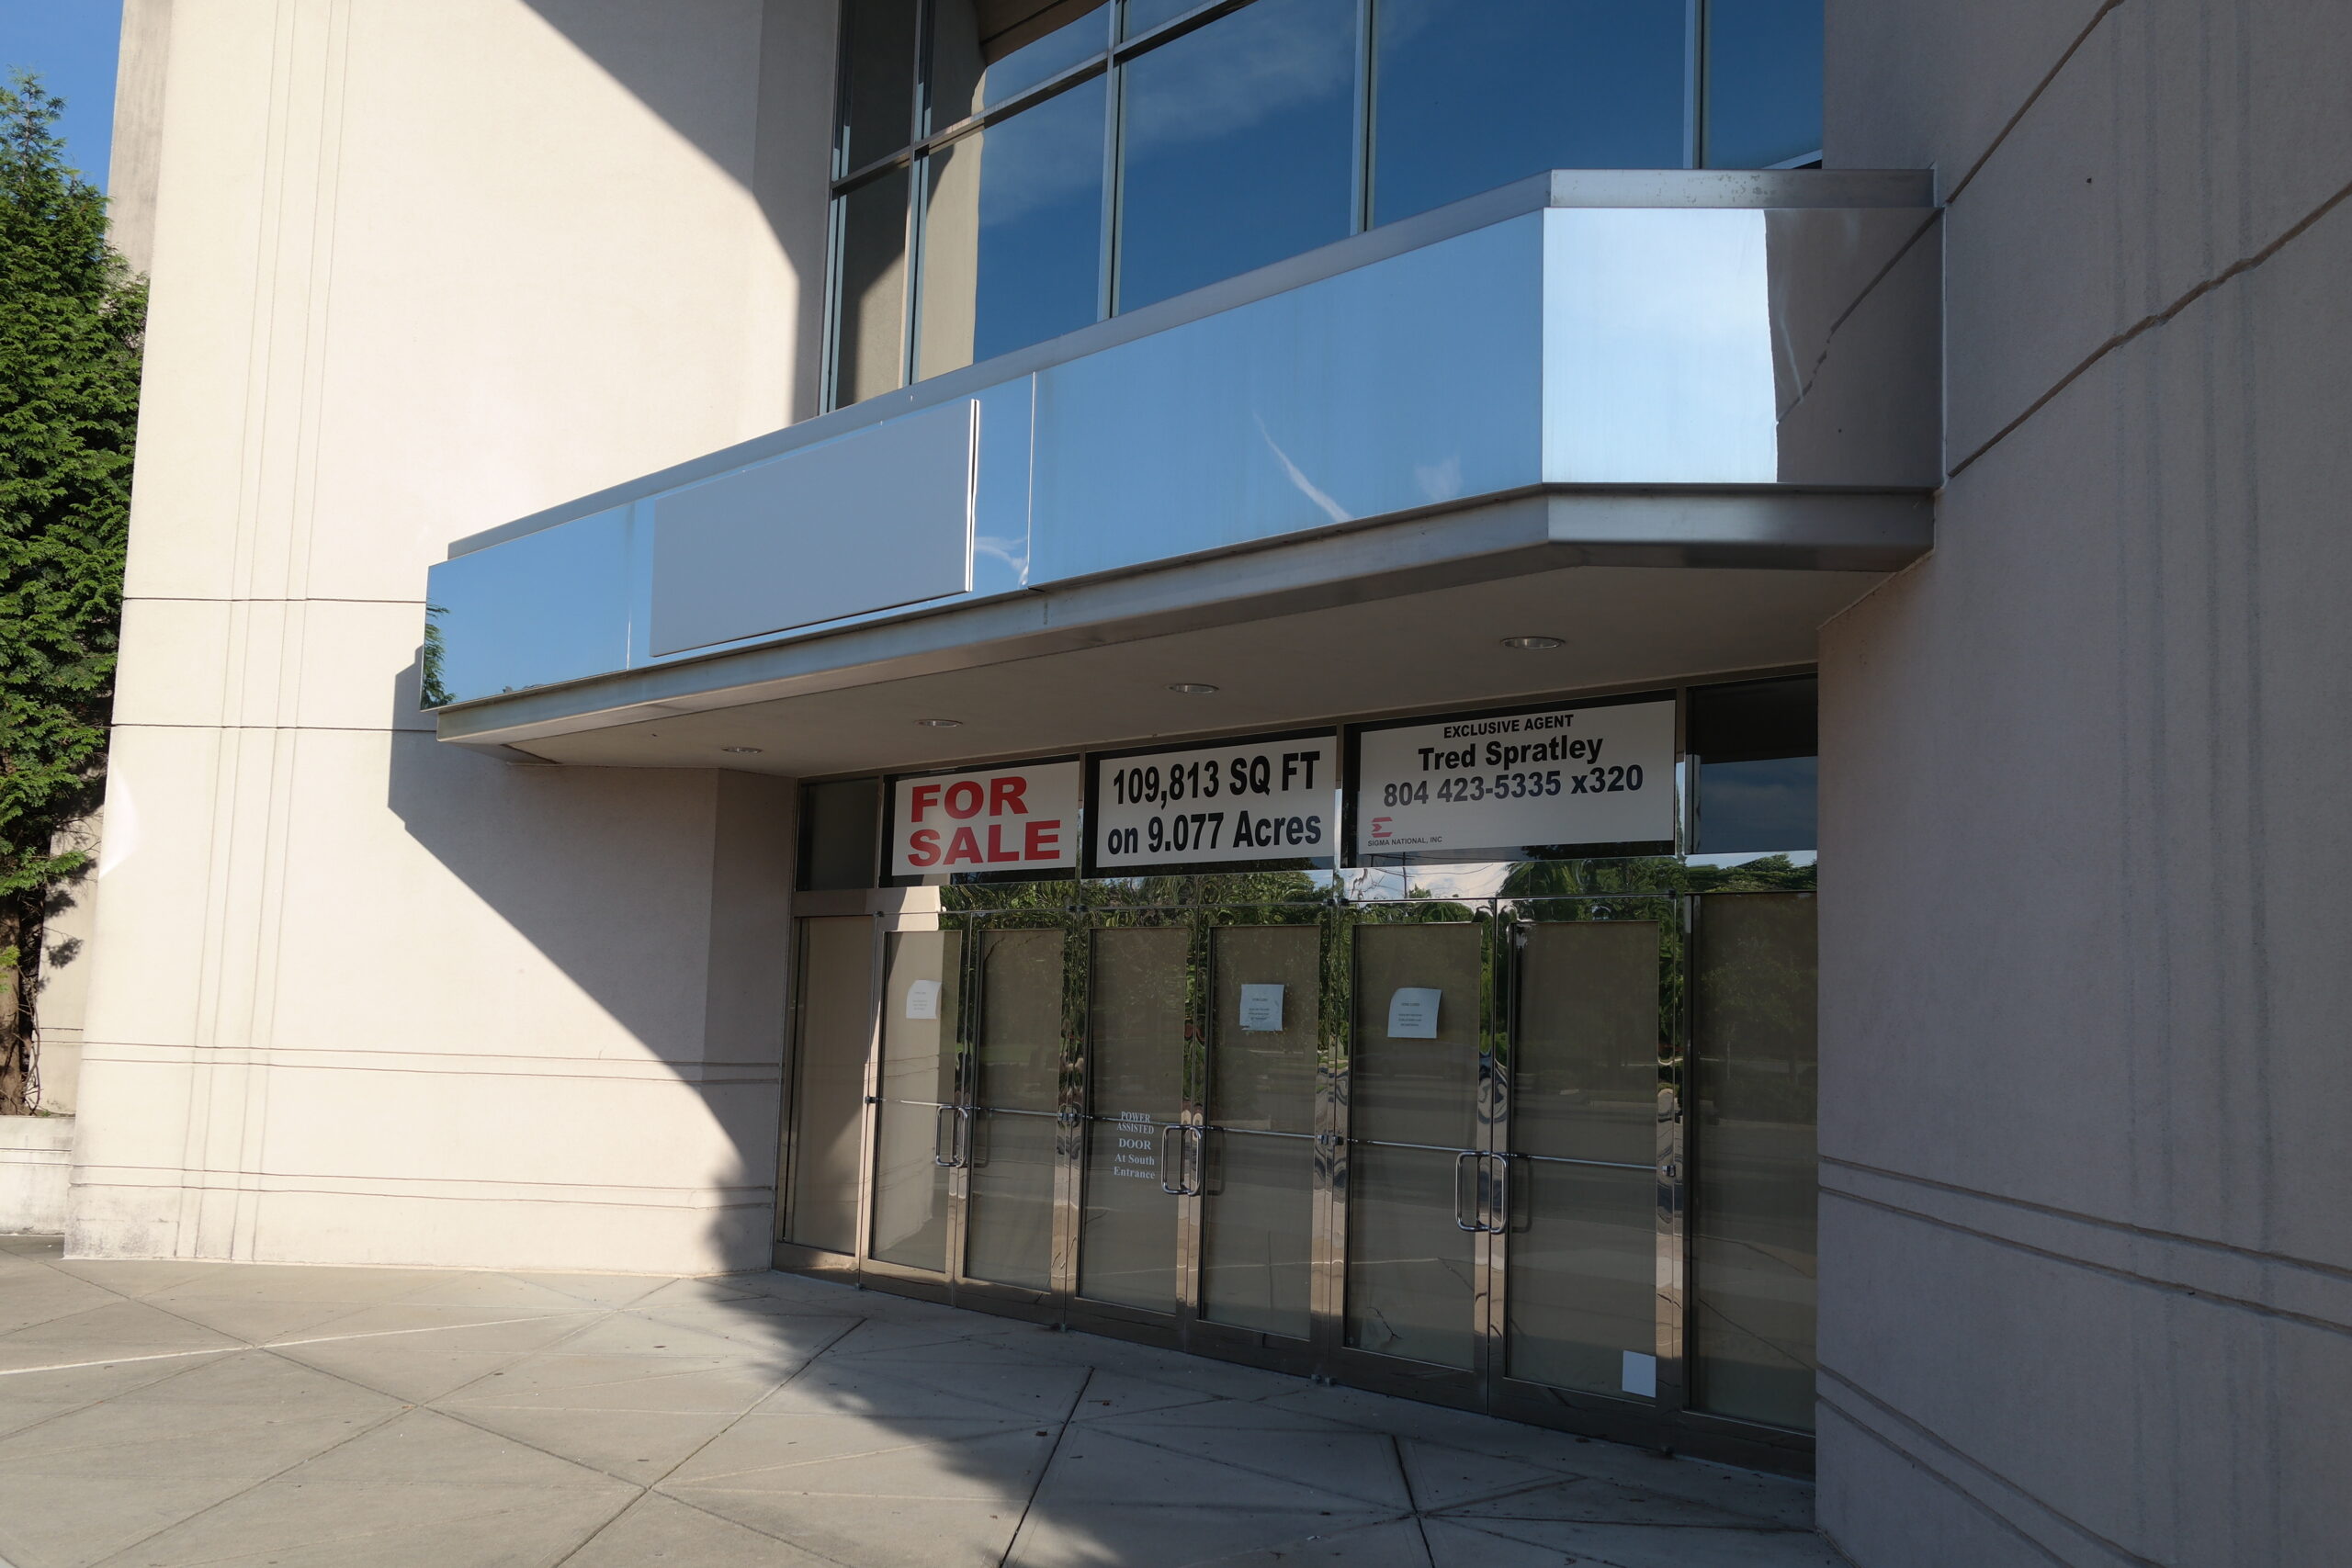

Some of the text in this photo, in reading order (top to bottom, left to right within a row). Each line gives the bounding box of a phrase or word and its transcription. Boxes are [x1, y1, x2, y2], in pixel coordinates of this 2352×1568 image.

[1443, 714, 1574, 739] EXCLUSIVE AGENT
[1418, 736, 1603, 771] Tred Spratley
[1113, 750, 1320, 808] 109,813 SQ FT
[1384, 764, 1644, 807] 804 423-5335 x320
[910, 775, 1029, 823] FOR
[907, 819, 1061, 866] SALE
[1108, 810, 1322, 854] on 9.077 Acres
[1391, 837, 1428, 845] NATIONAL,
[1116, 1122, 1154, 1134] ASSISTED
[1121, 1111, 1150, 1122] POWER
[1118, 1138, 1151, 1150] DOOR
[1114, 1153, 1155, 1166] At South
[1114, 1166, 1156, 1179] Entrance
